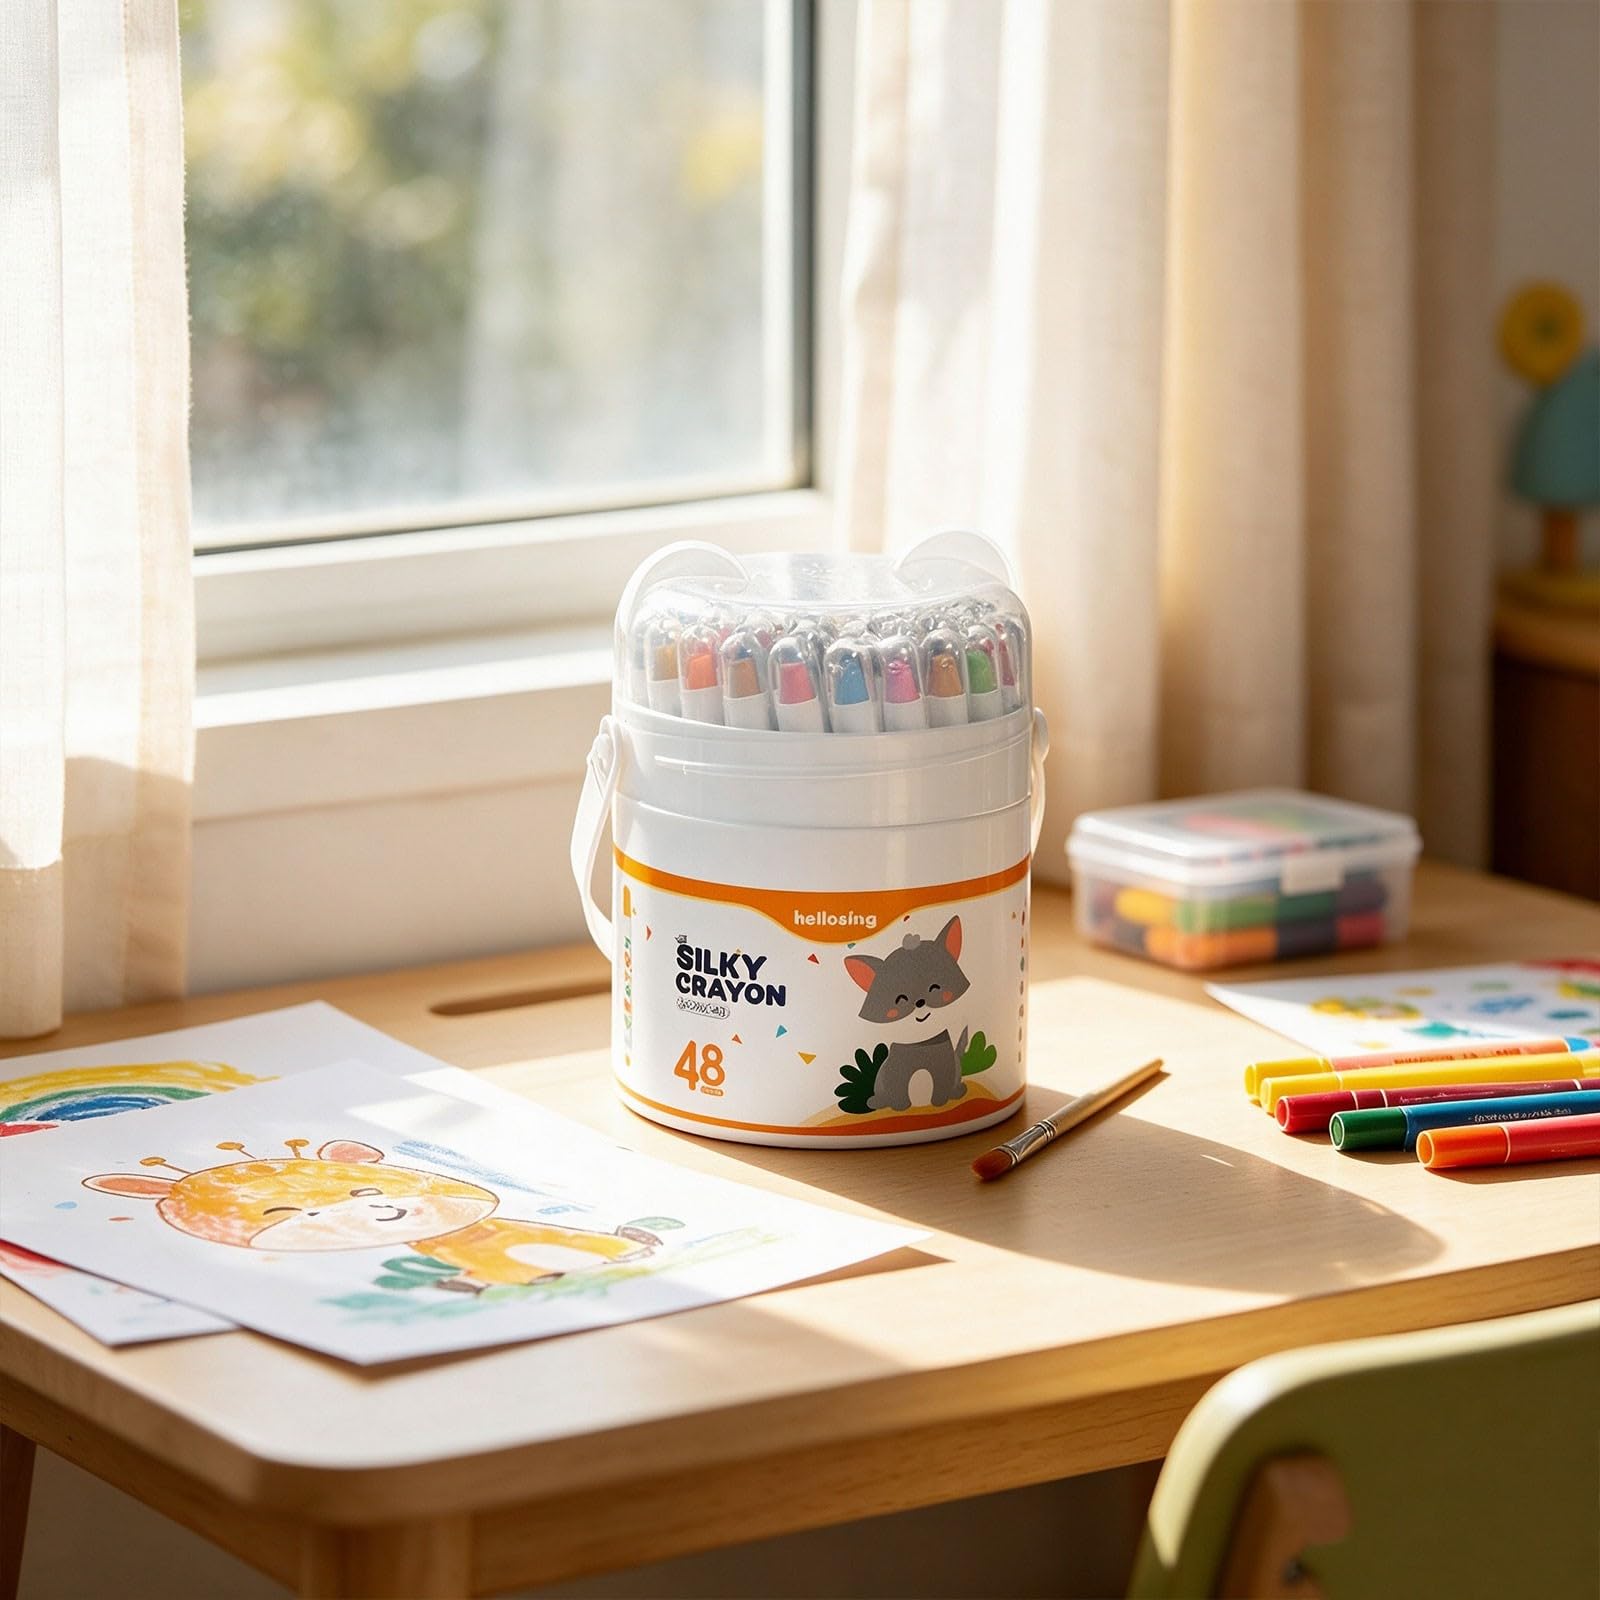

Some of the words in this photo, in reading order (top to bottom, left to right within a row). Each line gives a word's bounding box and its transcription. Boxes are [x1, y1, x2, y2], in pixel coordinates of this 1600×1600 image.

[793, 909, 877, 929] hellosing
[676, 944, 768, 981] SILKY
[675, 972, 786, 1007] CRAYON
[674, 1040, 726, 1091] 48
